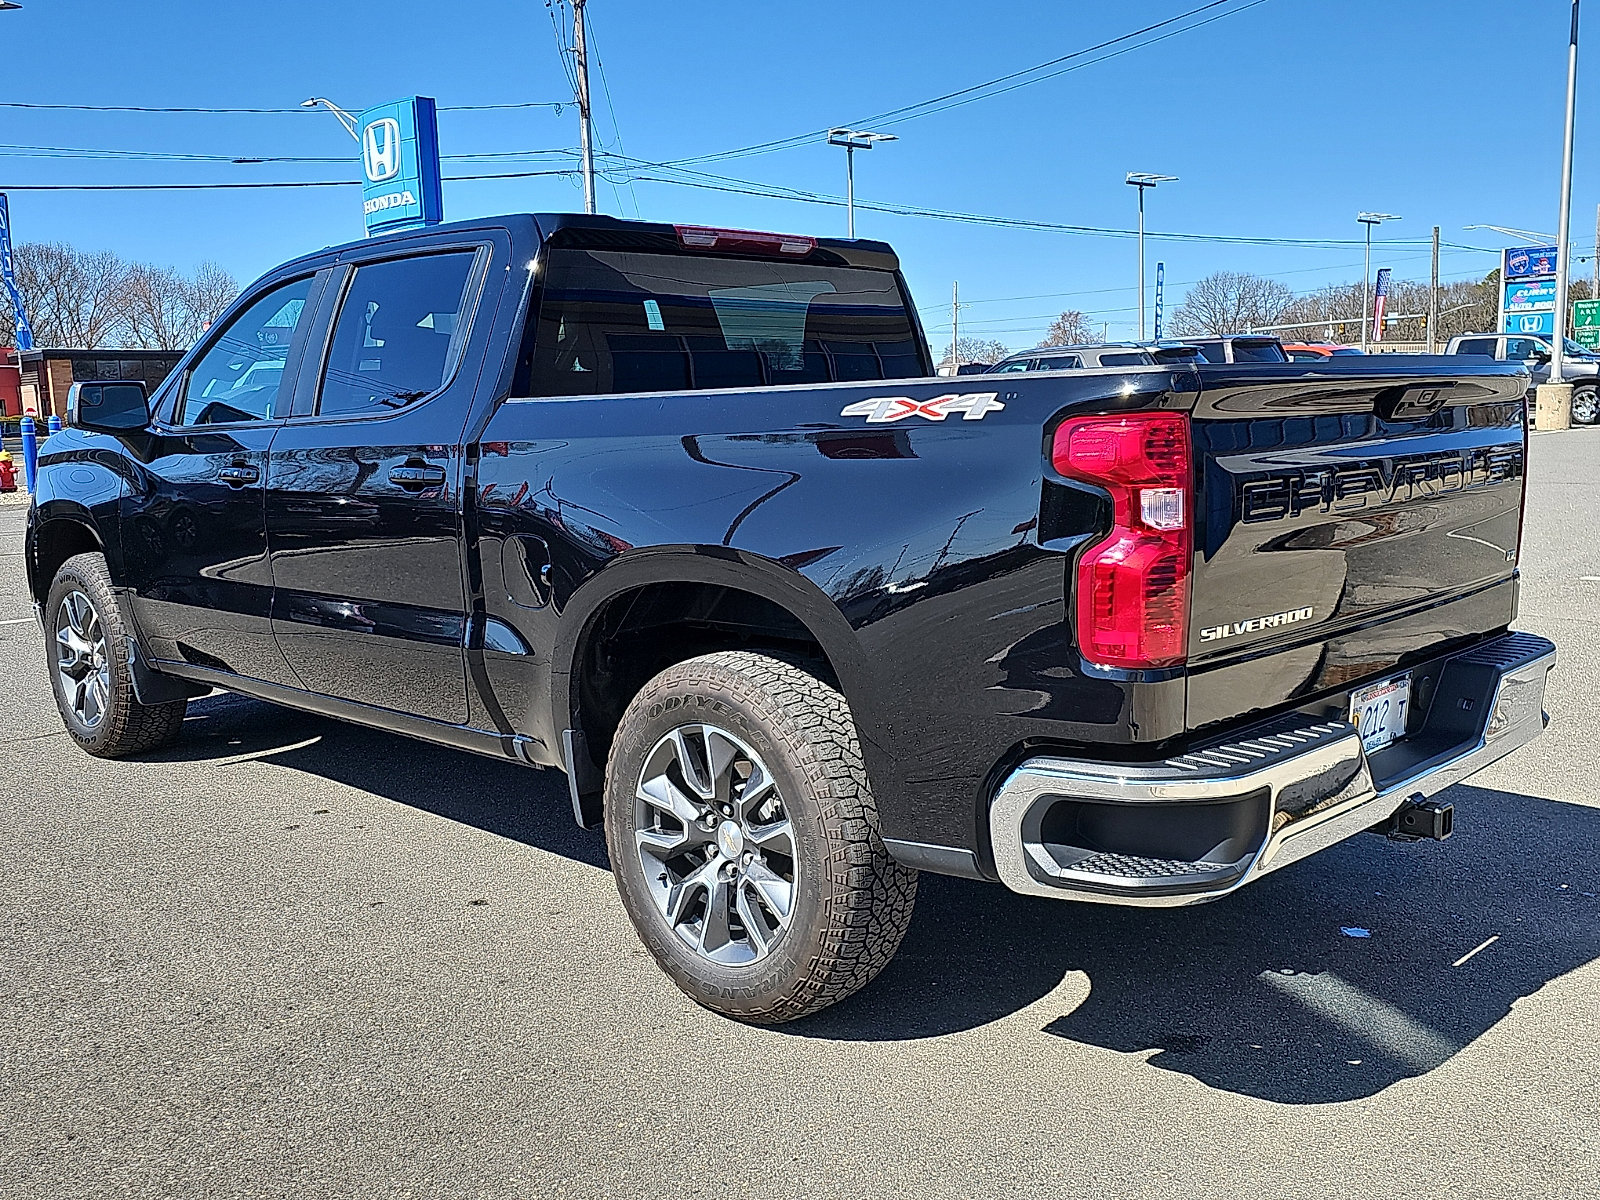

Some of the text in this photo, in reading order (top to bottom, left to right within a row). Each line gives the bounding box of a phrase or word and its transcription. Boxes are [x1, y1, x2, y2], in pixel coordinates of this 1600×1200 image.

[363, 191, 417, 215] HONDA
[1517, 288, 1557, 297] CURRY
[1509, 302, 1532, 310] AUTO
[1199, 606, 1314, 642] SILVERADO
[1362, 699, 1407, 741] 212 T
